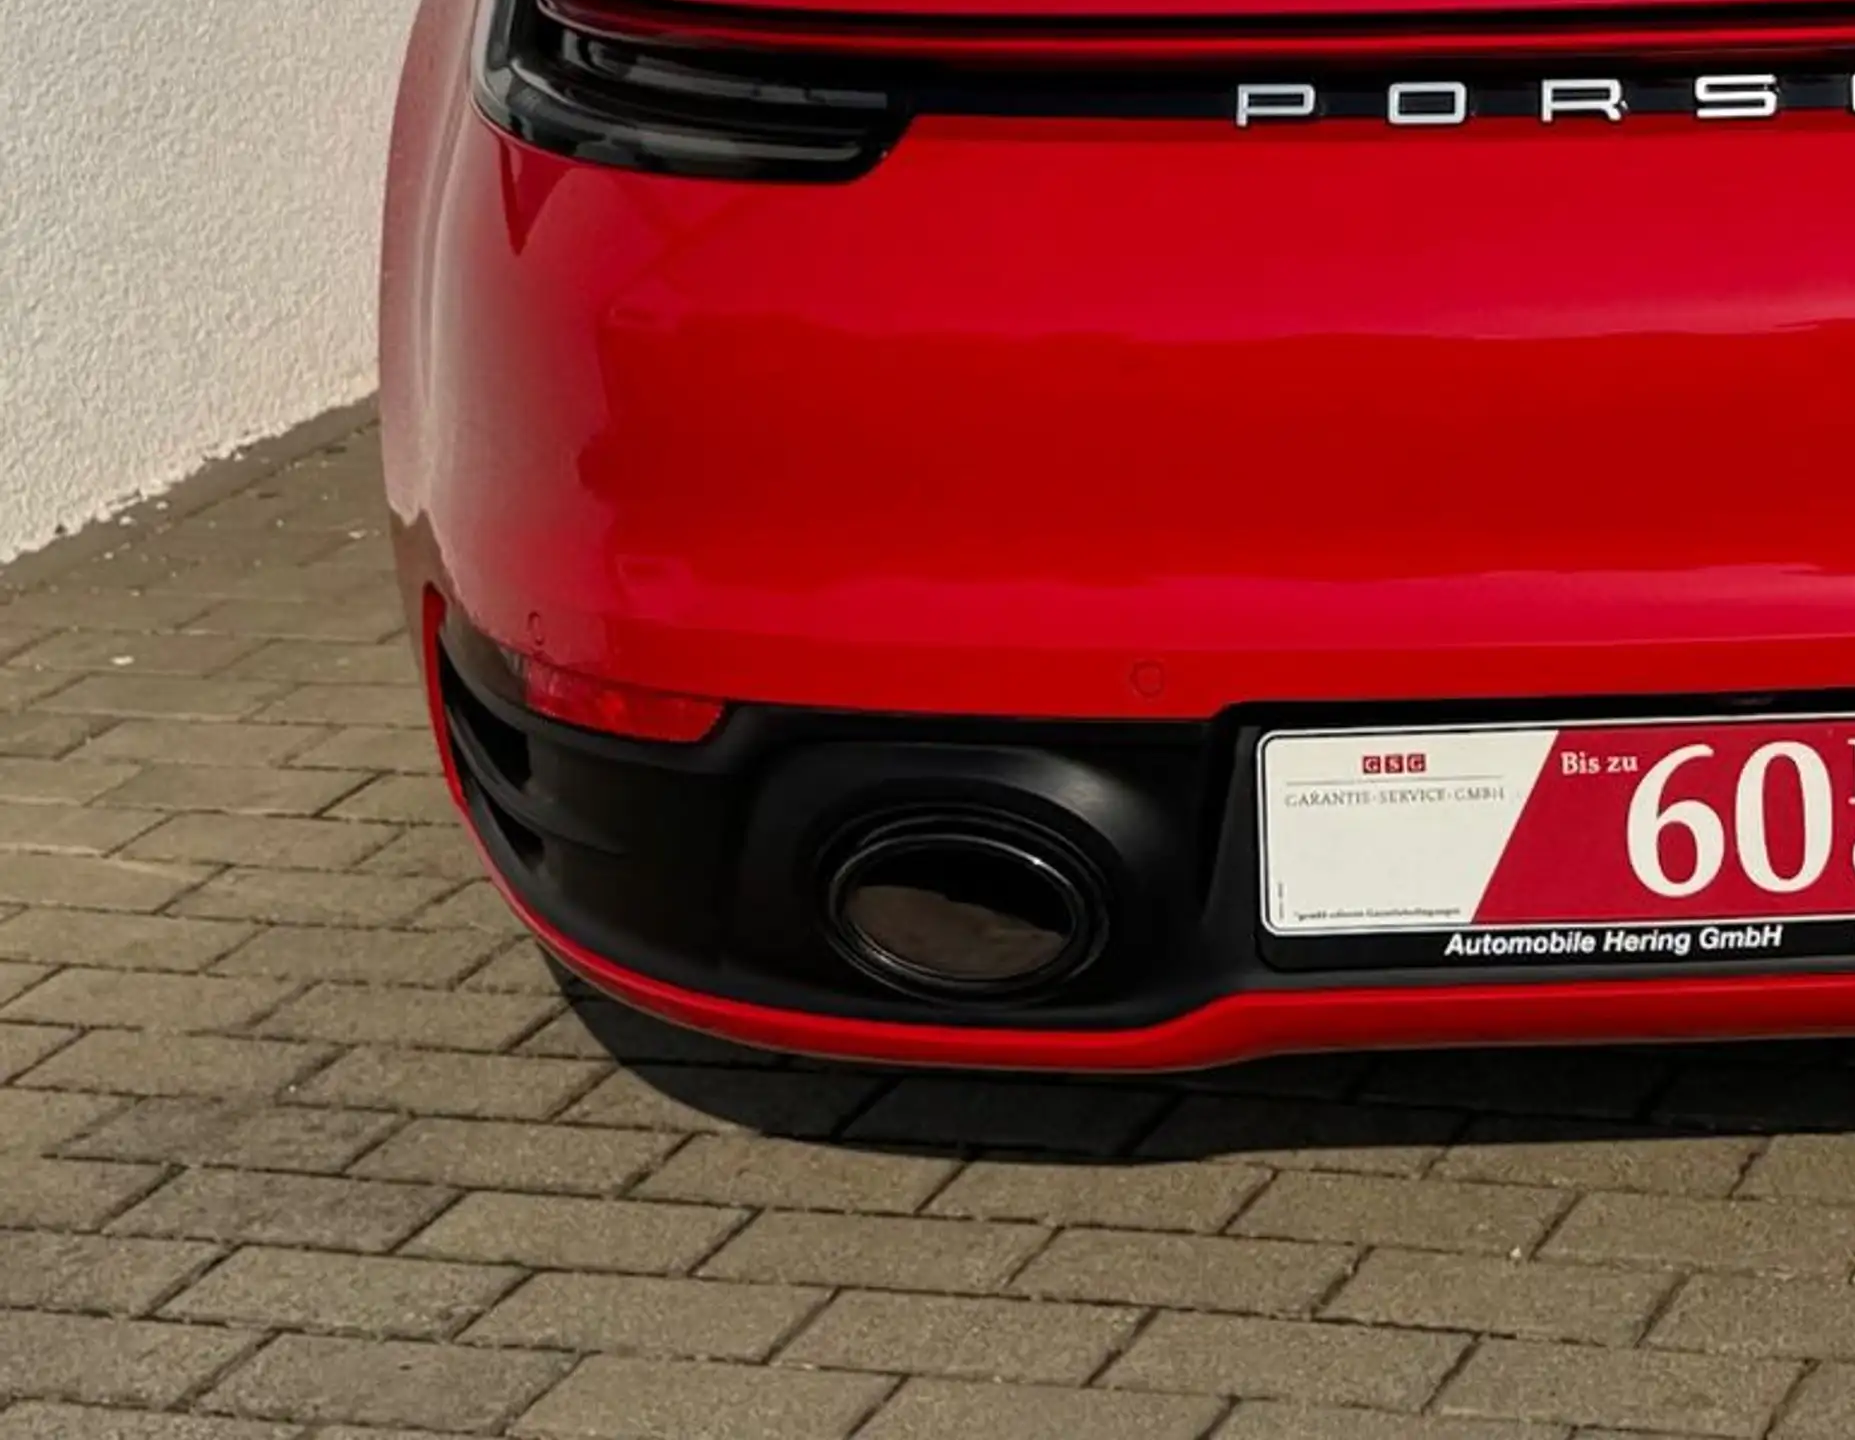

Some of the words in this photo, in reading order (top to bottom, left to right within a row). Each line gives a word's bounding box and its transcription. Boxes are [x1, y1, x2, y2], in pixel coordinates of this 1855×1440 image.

[1363, 753, 1427, 775] GSG
[1561, 751, 1601, 776] Bis
[1606, 754, 1639, 774] zu
[1627, 740, 1834, 899] 60
[1444, 931, 1597, 958] Automobile
[1602, 929, 1692, 957] Hering
[1698, 924, 1784, 950] GmbH
